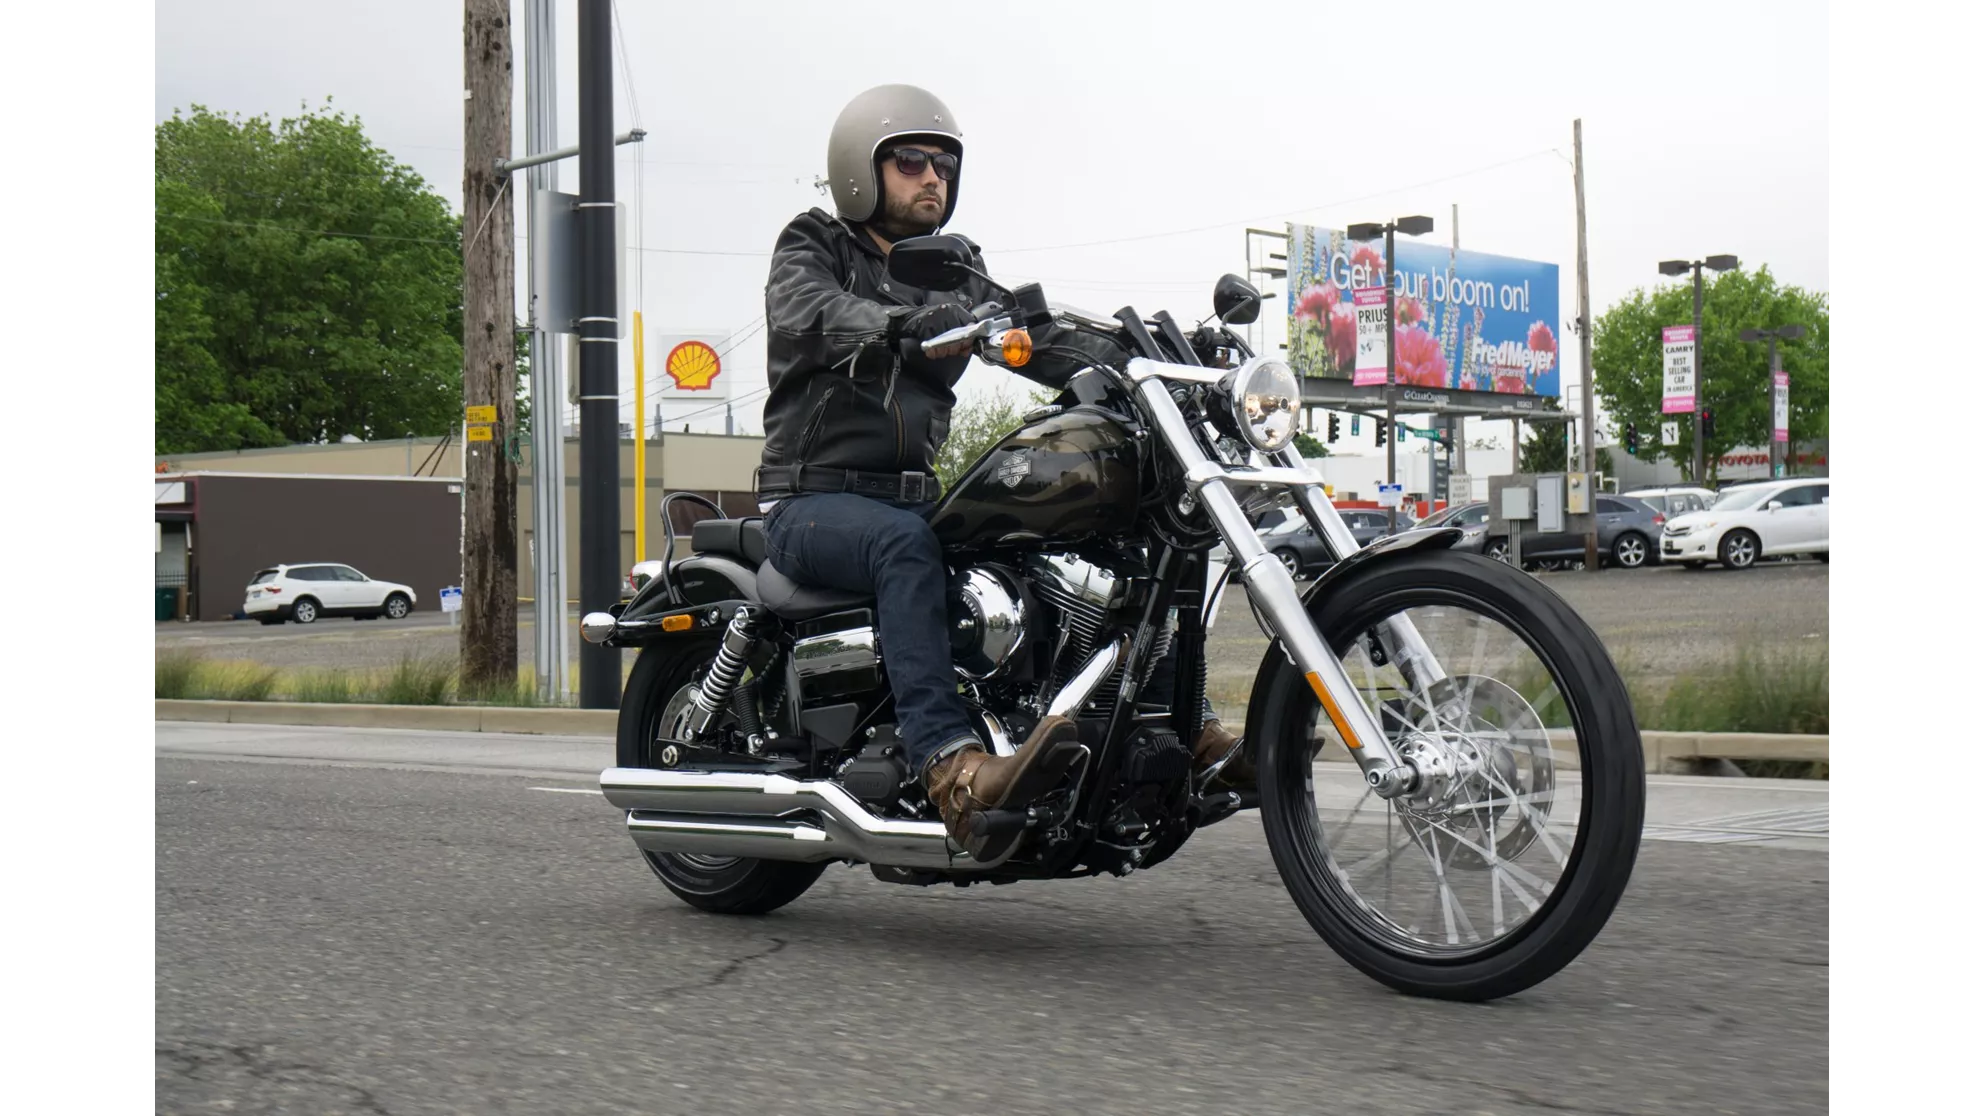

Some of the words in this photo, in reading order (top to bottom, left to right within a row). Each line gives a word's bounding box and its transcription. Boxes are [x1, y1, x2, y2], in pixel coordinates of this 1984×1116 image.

[1331, 251, 1372, 290] Get
[1432, 266, 1494, 308] bloom
[1501, 280, 1529, 313] on!
[1358, 308, 1388, 324] PRIUS
[1665, 345, 1694, 354] CAMRY
[1673, 357, 1686, 365] BEST
[1668, 366, 1691, 375] SELLING
[1674, 376, 1685, 384] CAR
[1719, 454, 1769, 466] TOYOTA
